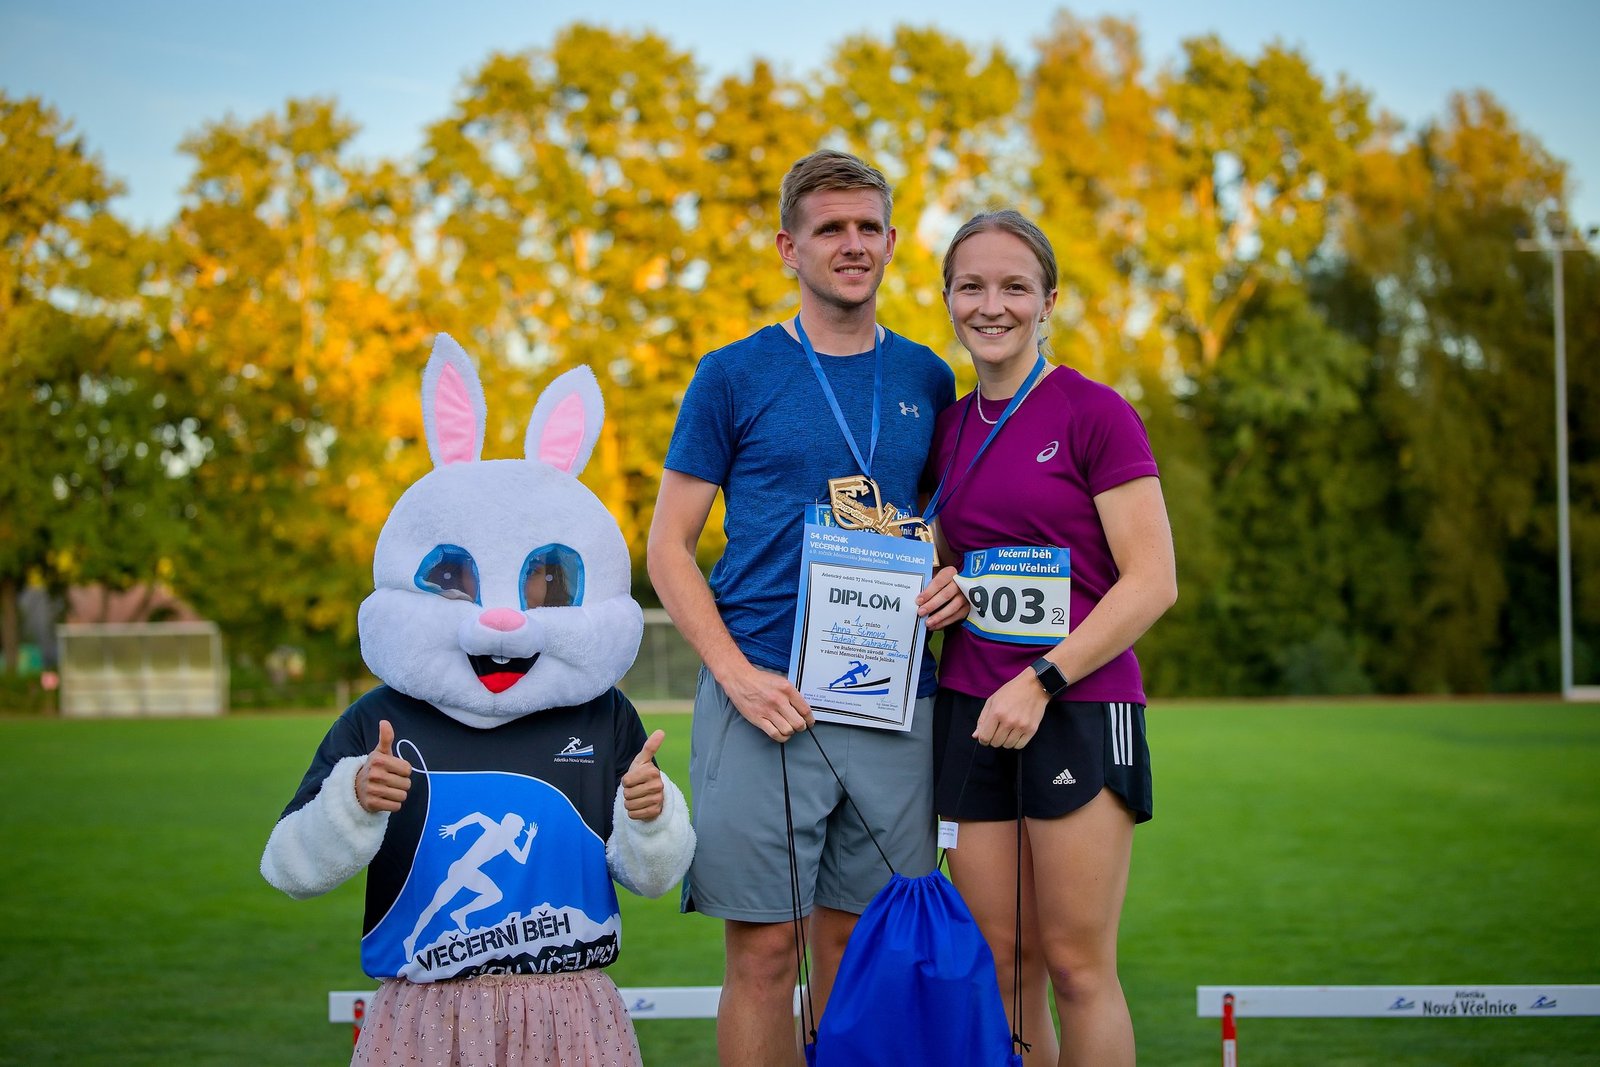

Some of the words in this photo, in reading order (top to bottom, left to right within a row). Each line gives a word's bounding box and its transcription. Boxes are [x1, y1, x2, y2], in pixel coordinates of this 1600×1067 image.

[810, 532, 821, 540] 54.
[823, 534, 849, 544] ROČNÍK
[810, 541, 849, 553] VEČERNÍHO
[850, 547, 869, 556] BĚHU
[869, 549, 894, 559] NOVOU
[895, 554, 926, 565] VČELNICÍ
[998, 548, 1030, 558] Večerní
[1032, 549, 1052, 559] běh
[989, 563, 1017, 572] Novou
[1020, 563, 1060, 574] Včelnicí
[828, 587, 901, 613] DIPLOM
[968, 586, 1046, 625] 903
[1051, 607, 1065, 625] 2
[831, 621, 851, 634] Anna
[865, 621, 881, 629] místo
[416, 917, 519, 972] VEČERNÍ
[523, 910, 572, 943] BĚH
[1422, 1000, 1458, 1016] Nová
[1461, 1000, 1518, 1015] Včelnice
